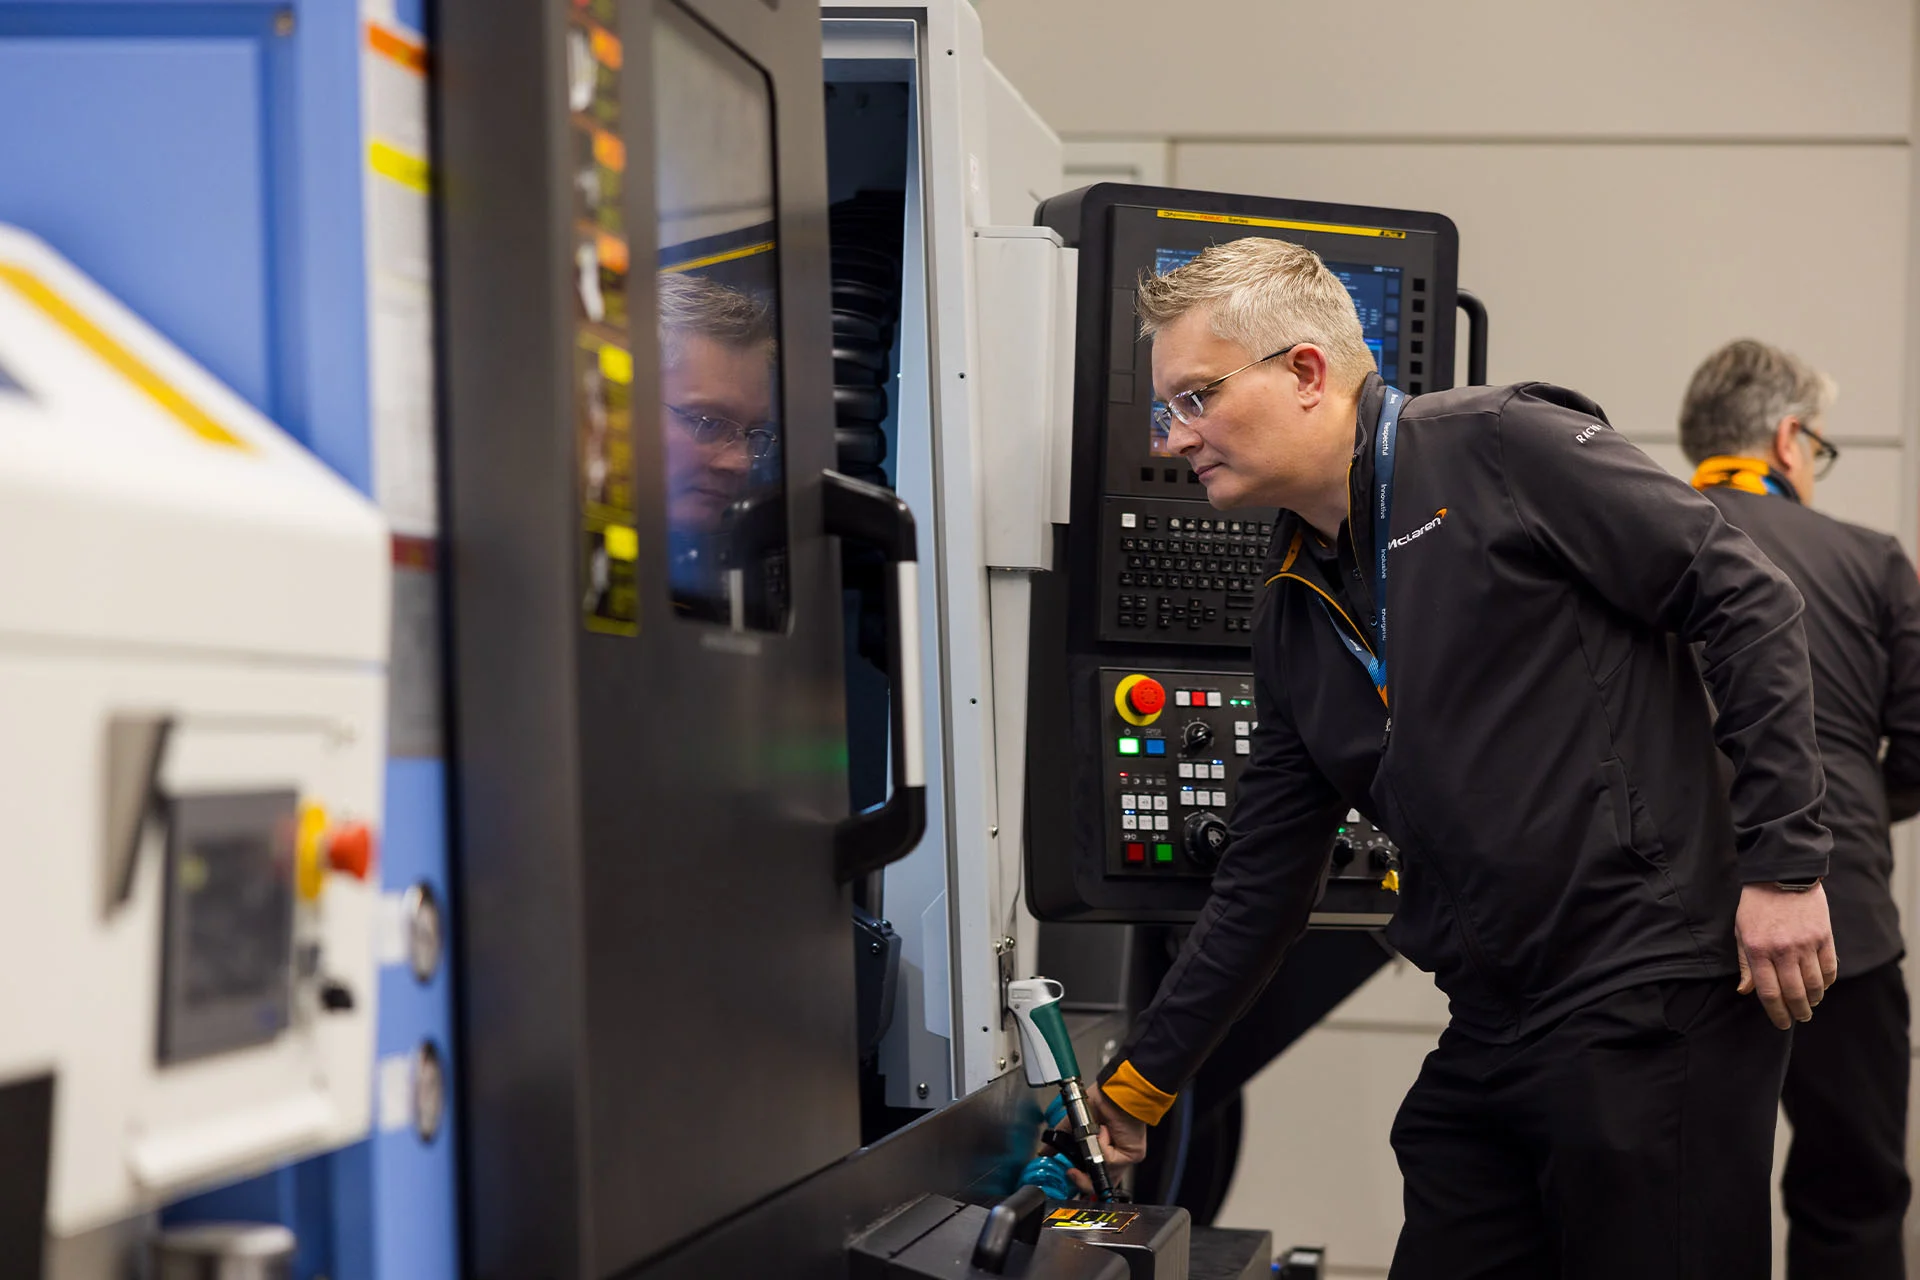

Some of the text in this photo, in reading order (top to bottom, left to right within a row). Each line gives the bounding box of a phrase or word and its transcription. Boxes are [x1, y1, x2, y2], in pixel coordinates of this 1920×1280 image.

[1382, 421, 1391, 456] Respectful
[1575, 424, 1602, 444] RACIN
[1380, 483, 1388, 519] Innovative
[1388, 517, 1441, 550] McLaren
